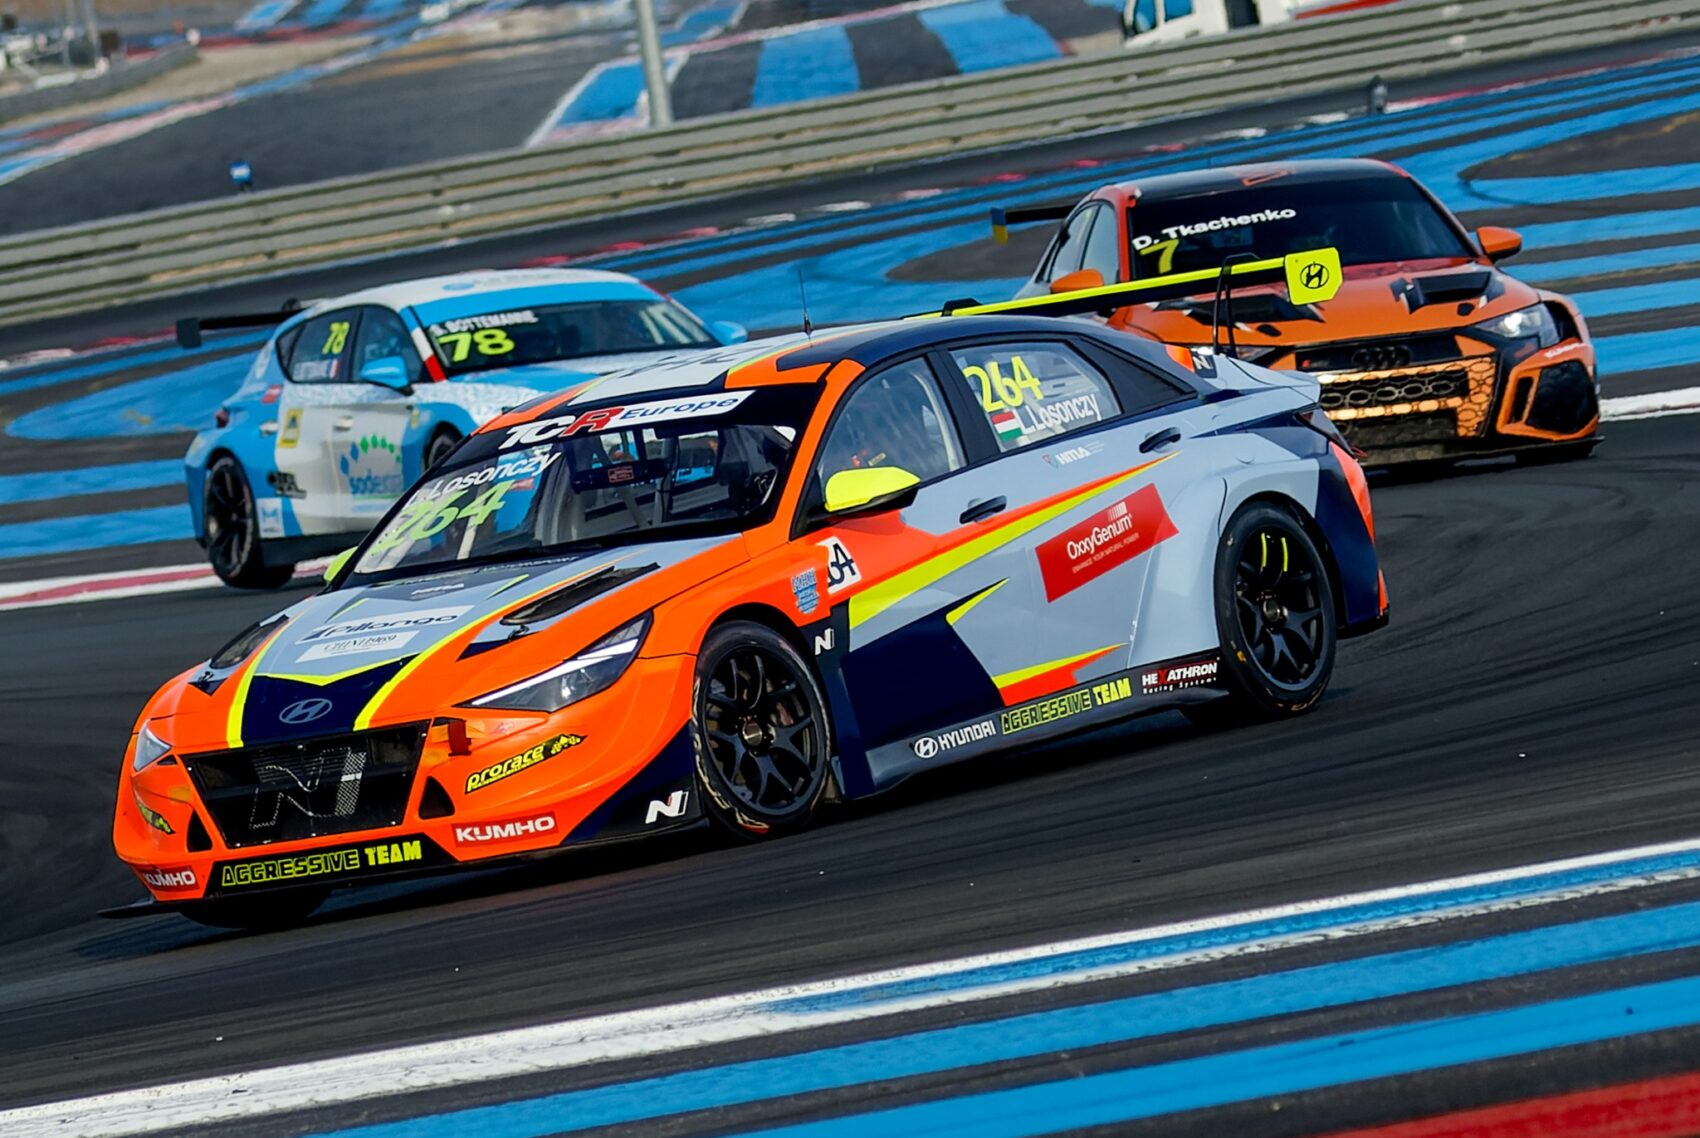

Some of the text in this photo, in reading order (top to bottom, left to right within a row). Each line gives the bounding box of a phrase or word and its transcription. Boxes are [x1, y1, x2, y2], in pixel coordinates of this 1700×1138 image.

[1132, 208, 1297, 251] D. Tkachenko
[1139, 238, 1180, 275] 7
[322, 321, 350, 355] 78
[437, 328, 516, 363] 78
[962, 354, 1044, 414] 264
[498, 397, 739, 450] TCR Europe
[369, 479, 516, 553] 264
[1142, 662, 1218, 687] HEXATHRON
[1142, 684, 1174, 695] Racing
[1001, 678, 1132, 735] AGGRESSIVE TEAM
[938, 719, 996, 751] HYUNDAI
[466, 744, 545, 792] prorace
[455, 816, 556, 842] KUMHO
[221, 840, 423, 888] AGGRESSIVE TEAM
